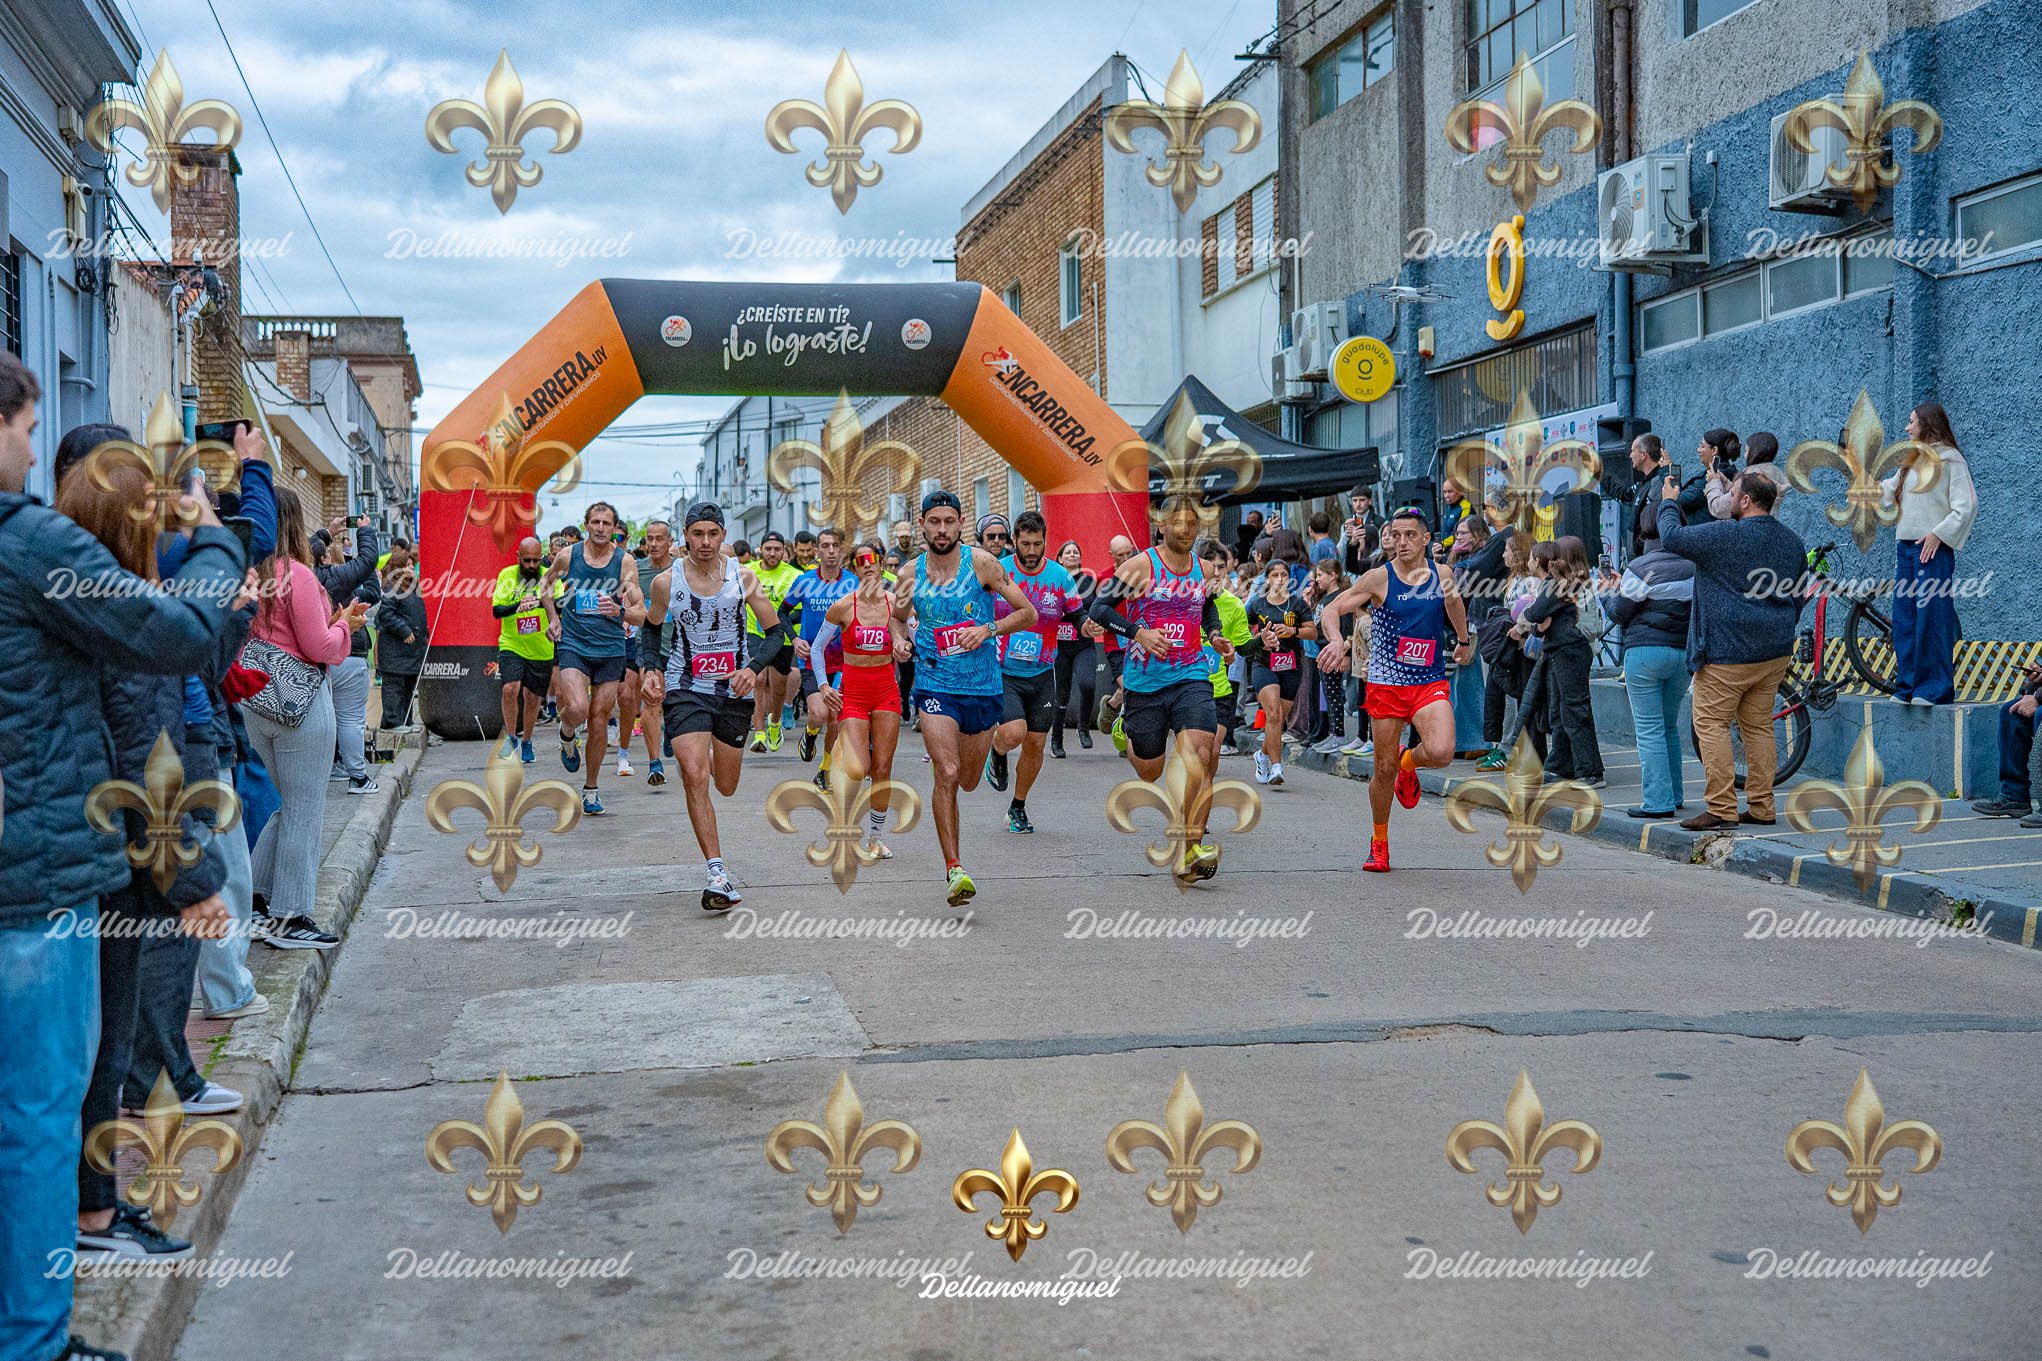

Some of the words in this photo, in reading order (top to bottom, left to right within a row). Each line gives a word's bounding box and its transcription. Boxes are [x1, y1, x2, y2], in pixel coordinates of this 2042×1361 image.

[737, 304, 803, 325] ¿CREÍSTE
[806, 306, 827, 324] EN
[828, 304, 850, 324] TÍ?
[765, 320, 873, 367] lograste!
[1342, 343, 1389, 366] guadalupe
[1355, 387, 1374, 396] club
[520, 617, 538, 630] 245
[1057, 625, 1073, 635] 205
[1163, 623, 1185, 639] 199
[862, 629, 884, 644] 178
[942, 627, 966, 647] 17
[1014, 640, 1038, 654] 425
[1403, 642, 1430, 658] 207
[698, 656, 729, 673] 234
[1275, 656, 1293, 666] 224
